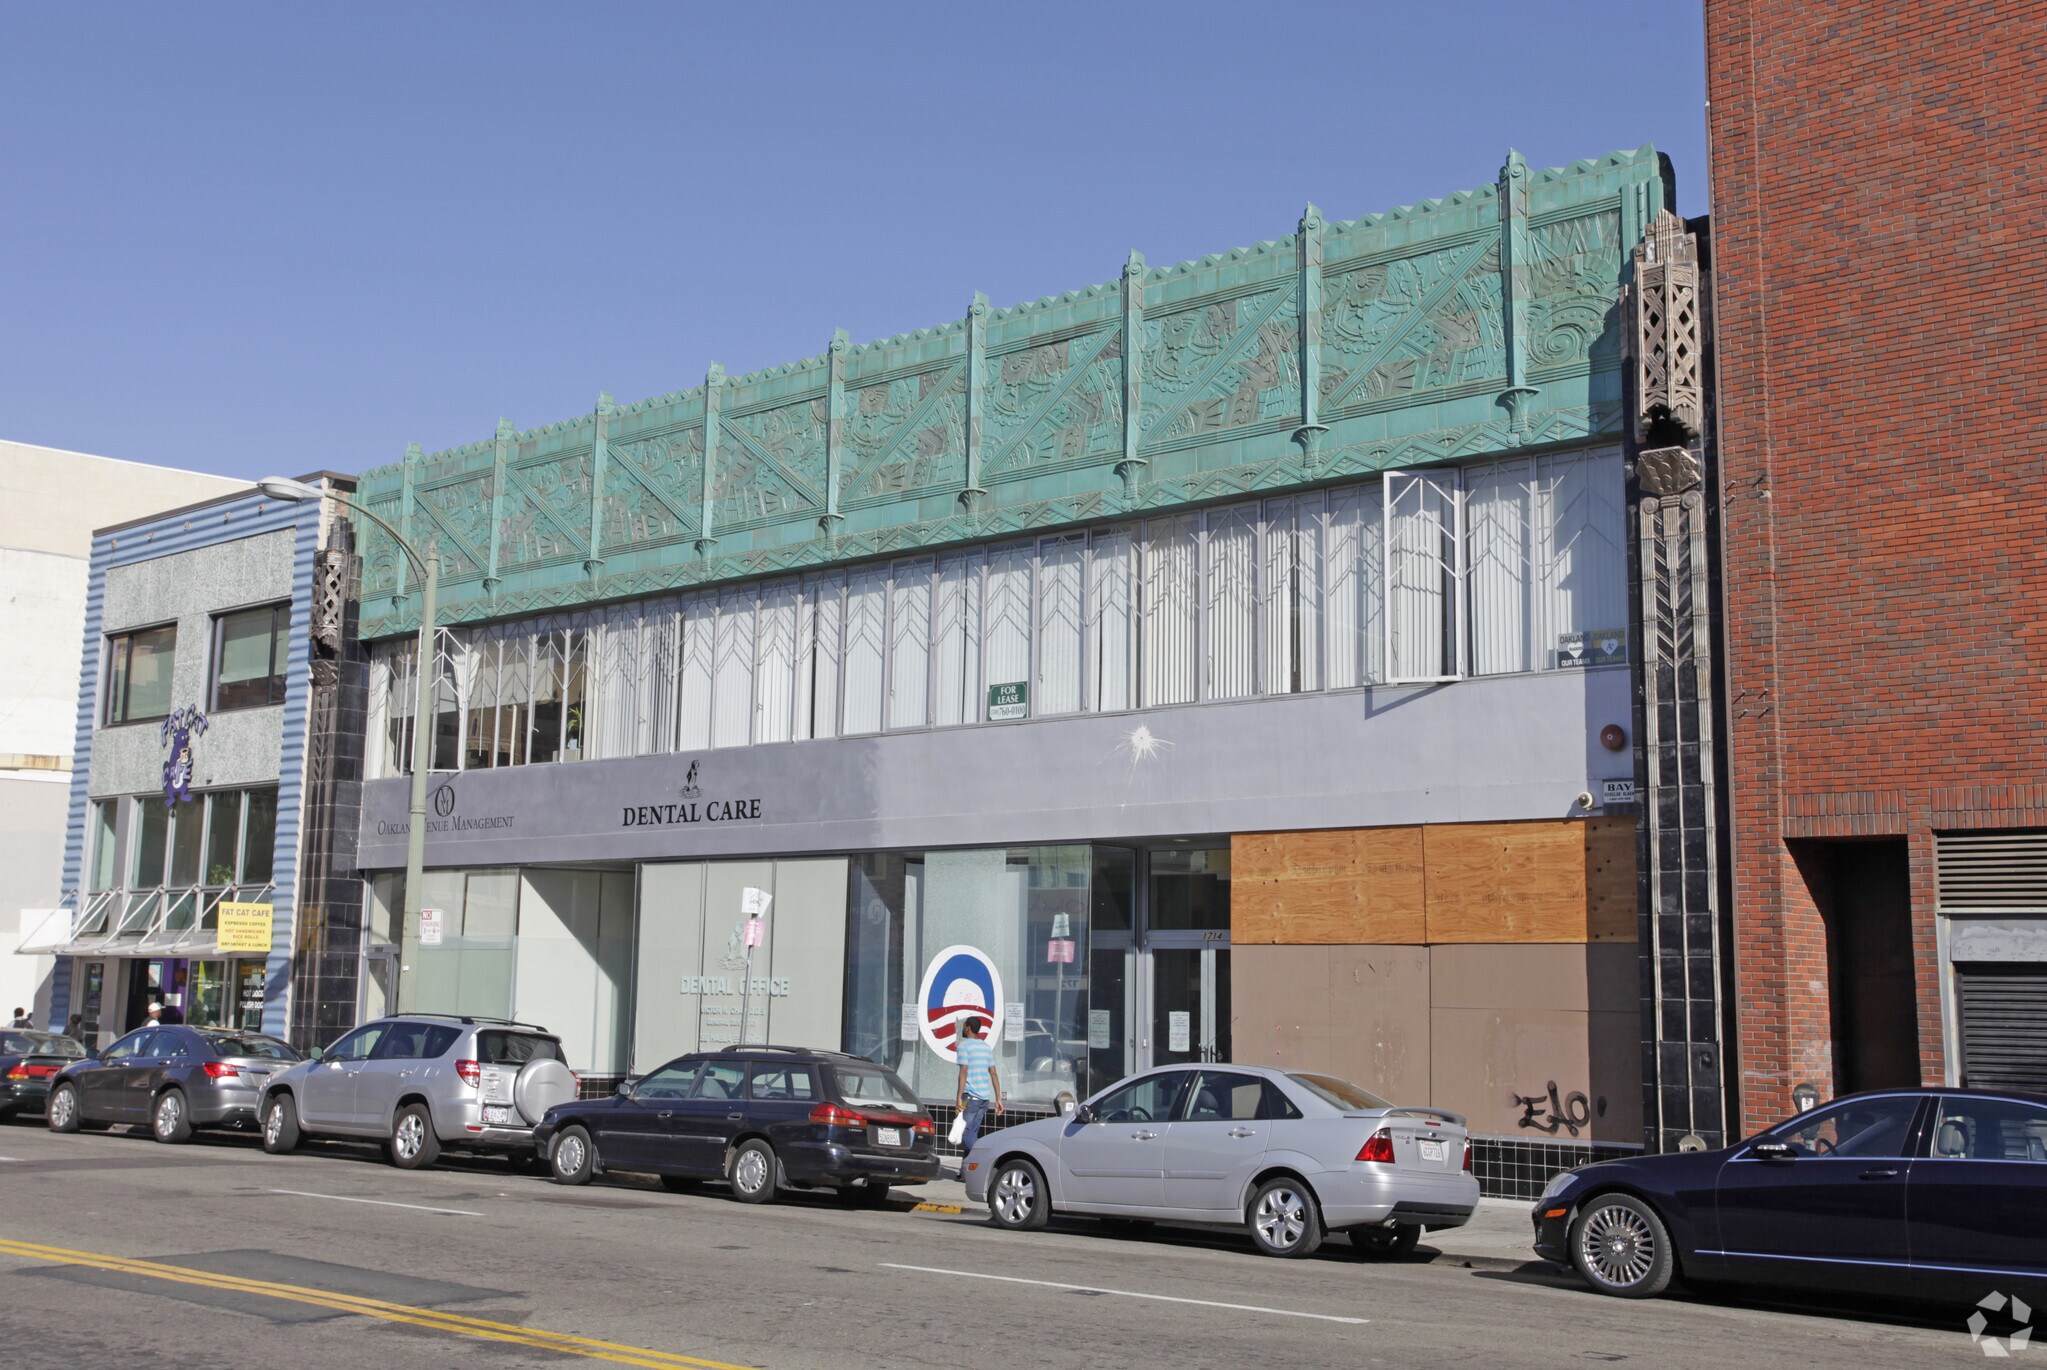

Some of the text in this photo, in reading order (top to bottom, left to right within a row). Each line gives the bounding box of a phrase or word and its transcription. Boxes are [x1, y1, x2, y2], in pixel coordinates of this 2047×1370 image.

[1560, 633, 1590, 644] OAKLAND
[1573, 657, 1591, 666] TEAMS
[1000, 686, 1017, 695] FOR
[997, 694, 1019, 704] LEASE
[161, 708, 184, 747] FAT
[162, 758, 193, 788] CAFE
[1608, 783, 1632, 792] BAY
[622, 799, 762, 827] DENTAL CARE
[377, 820, 411, 835] OAKLAN
[452, 815, 515, 831] MANAGEMENT
[221, 908, 270, 918] FAT CAT CAFE
[421, 910, 432, 920] NO
[1203, 932, 1223, 940] 1714
[680, 976, 789, 998] DENTAL OFFICE
[252, 990, 264, 998] DOGS
[239, 1001, 264, 1009] POLISH DOG
[700, 1034, 764, 1045] SE HABLA ESAÑOL
